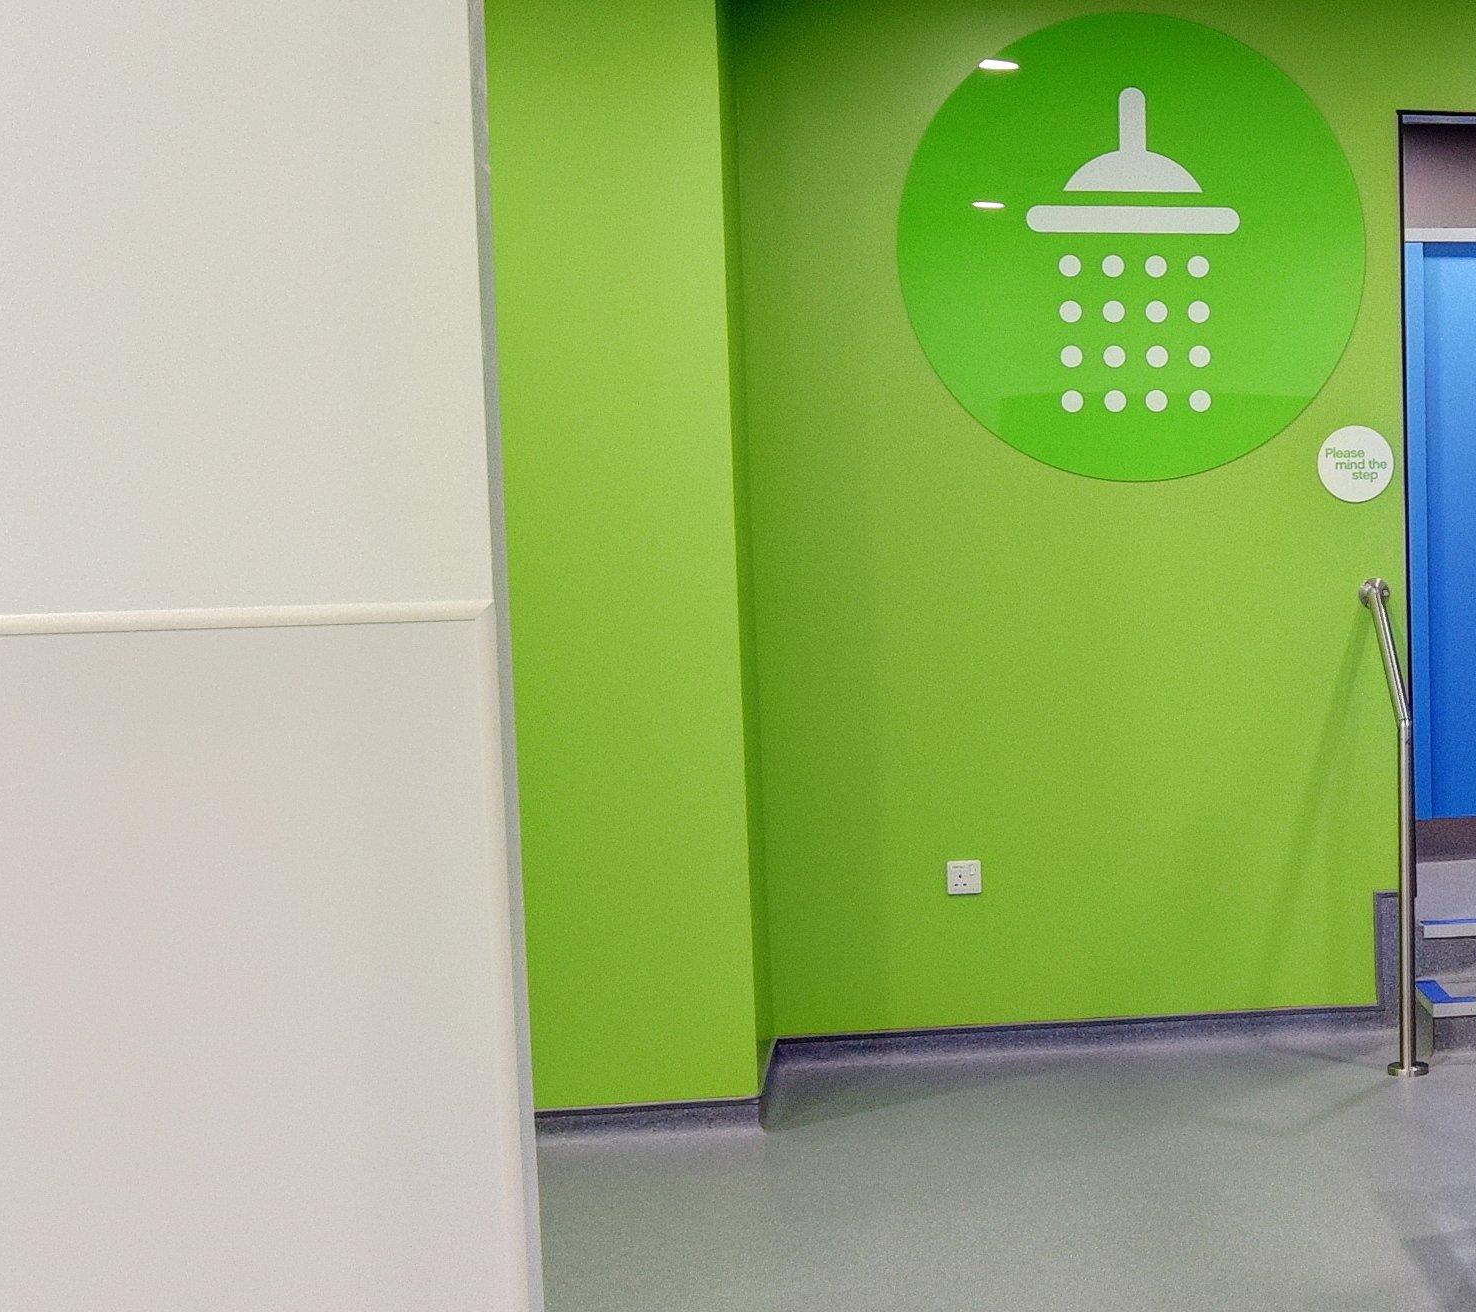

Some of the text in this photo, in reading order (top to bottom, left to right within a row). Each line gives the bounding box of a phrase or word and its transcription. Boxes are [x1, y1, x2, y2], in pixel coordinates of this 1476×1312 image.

[1325, 447, 1365, 458] Please
[1335, 458, 1388, 469] mind the
[1352, 471, 1379, 483] step
